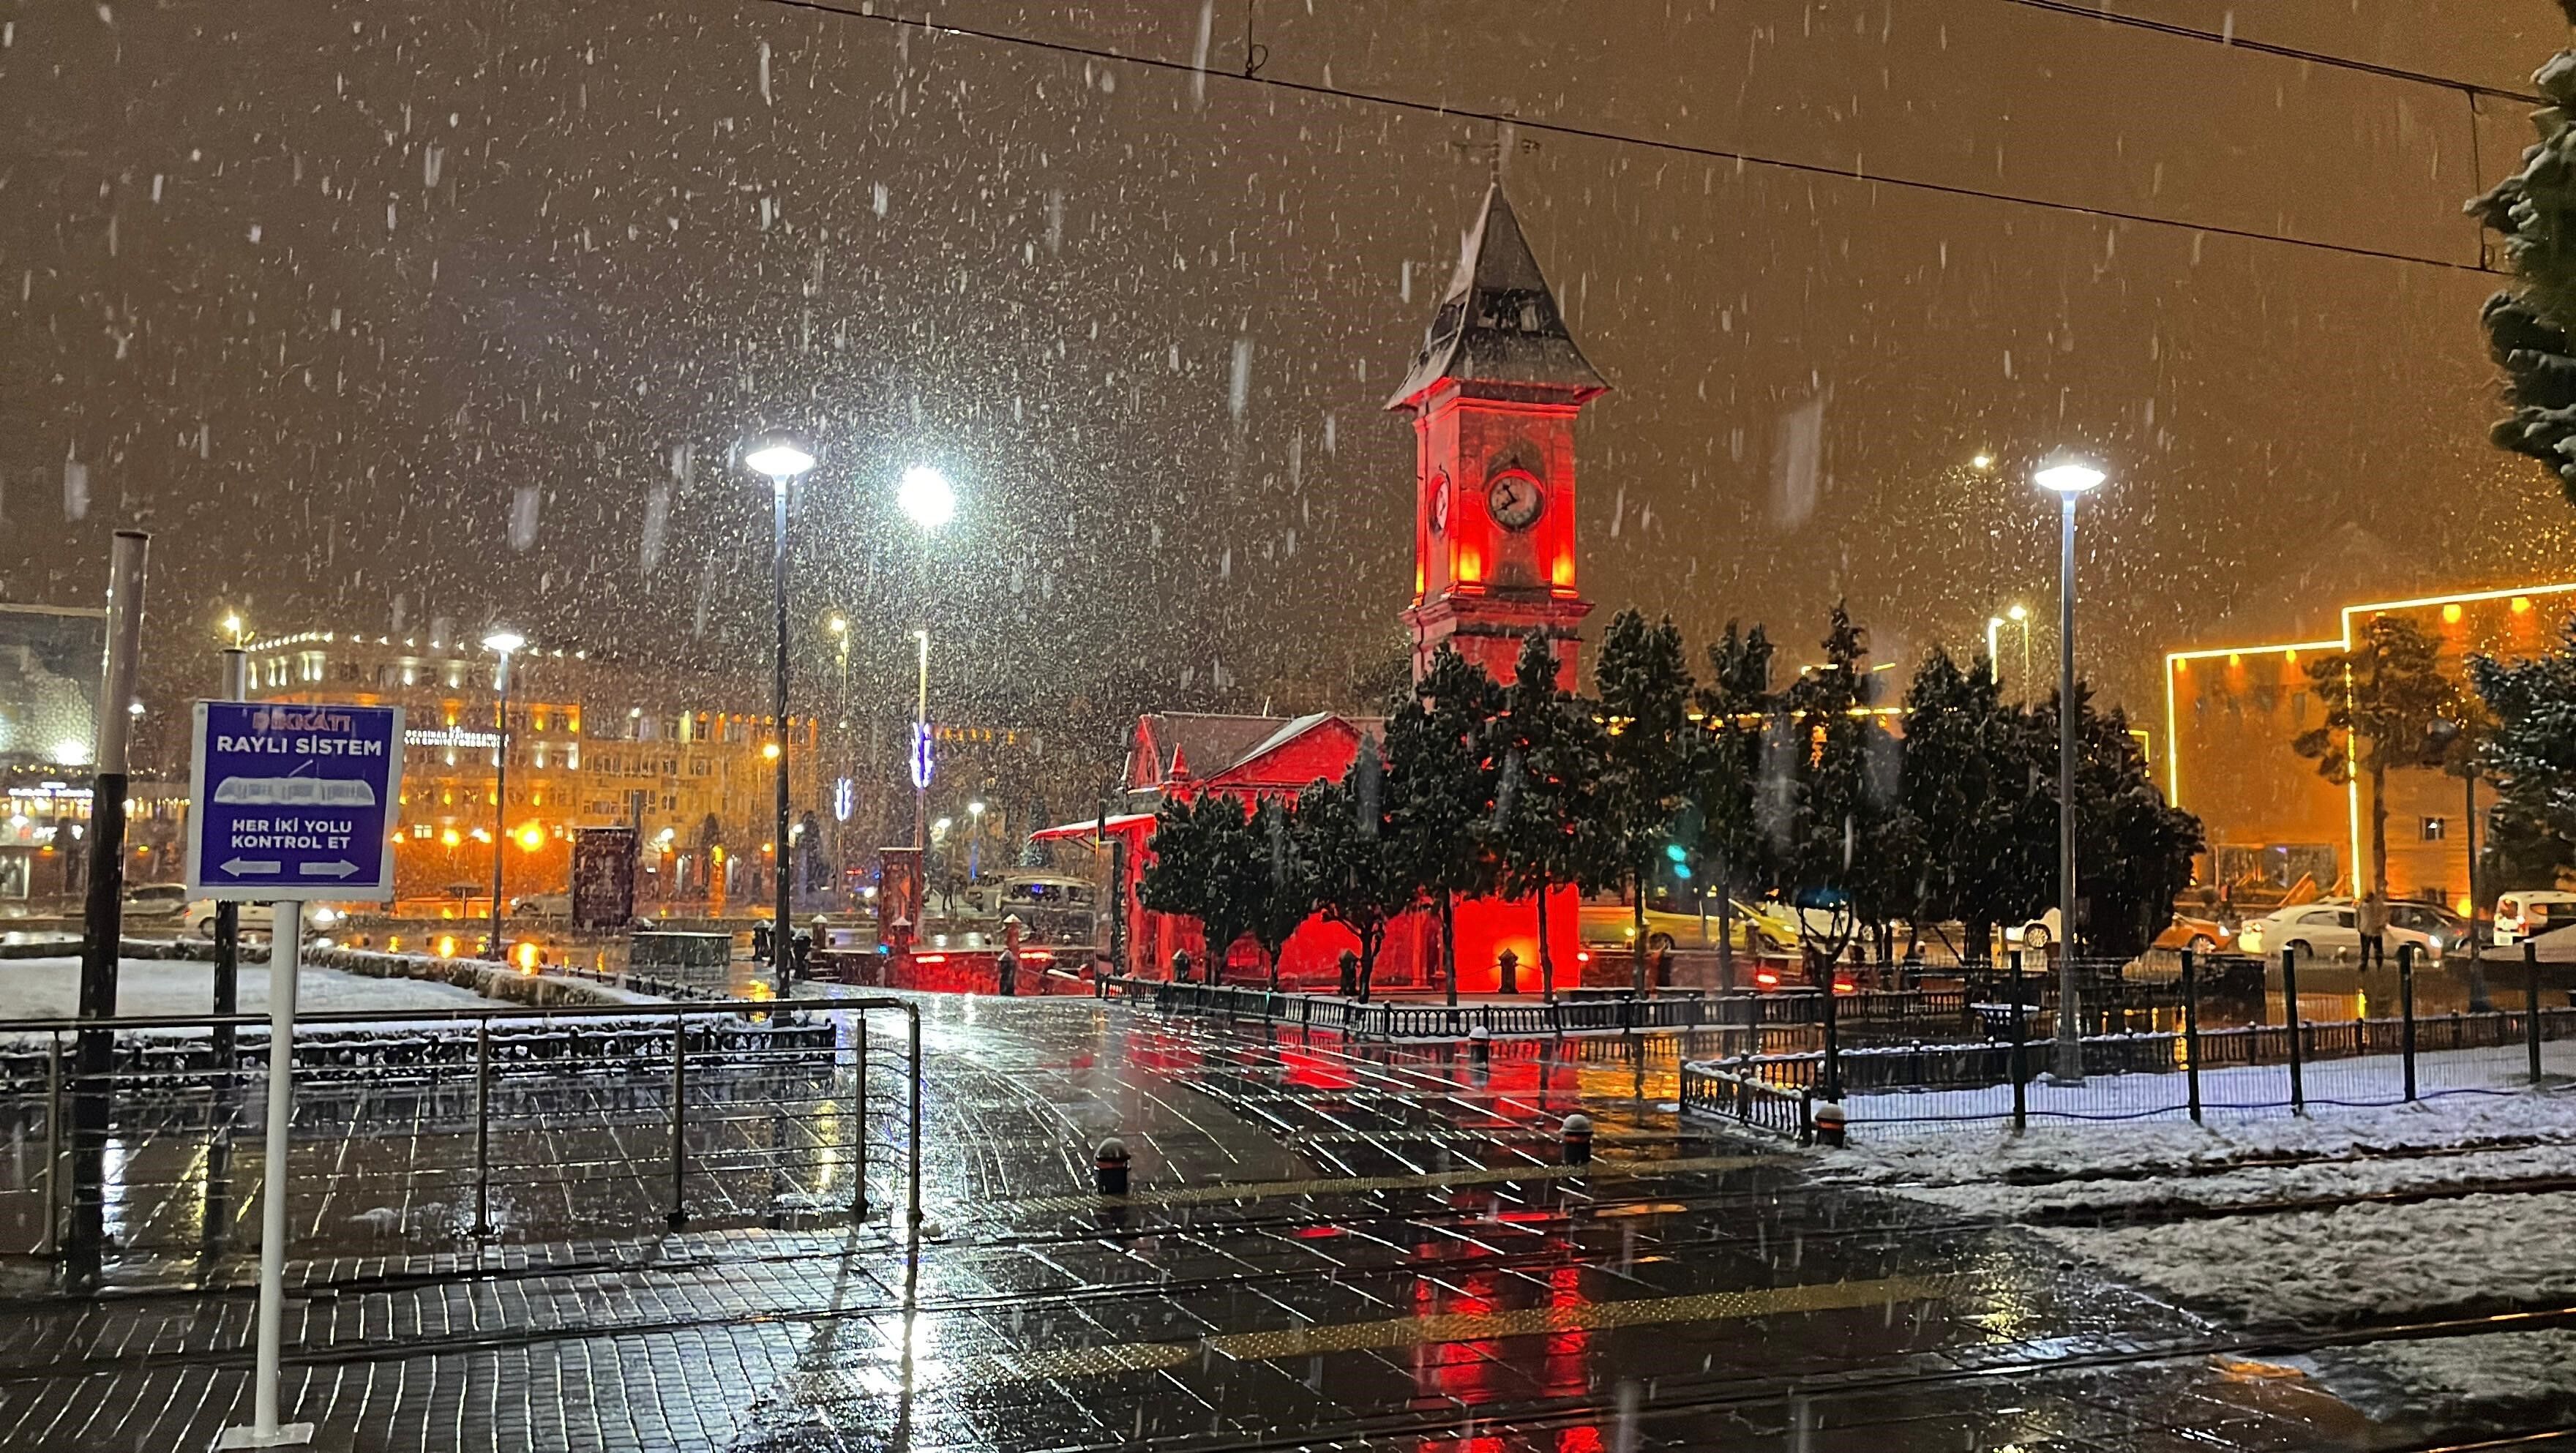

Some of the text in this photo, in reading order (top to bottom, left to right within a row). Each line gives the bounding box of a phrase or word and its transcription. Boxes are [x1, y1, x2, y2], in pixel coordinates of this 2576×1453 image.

[217, 735, 382, 756] RAYLI SİSTEM
[232, 817, 352, 833] HER İKİ YOLU
[231, 835, 351, 849] KONTROL ET
